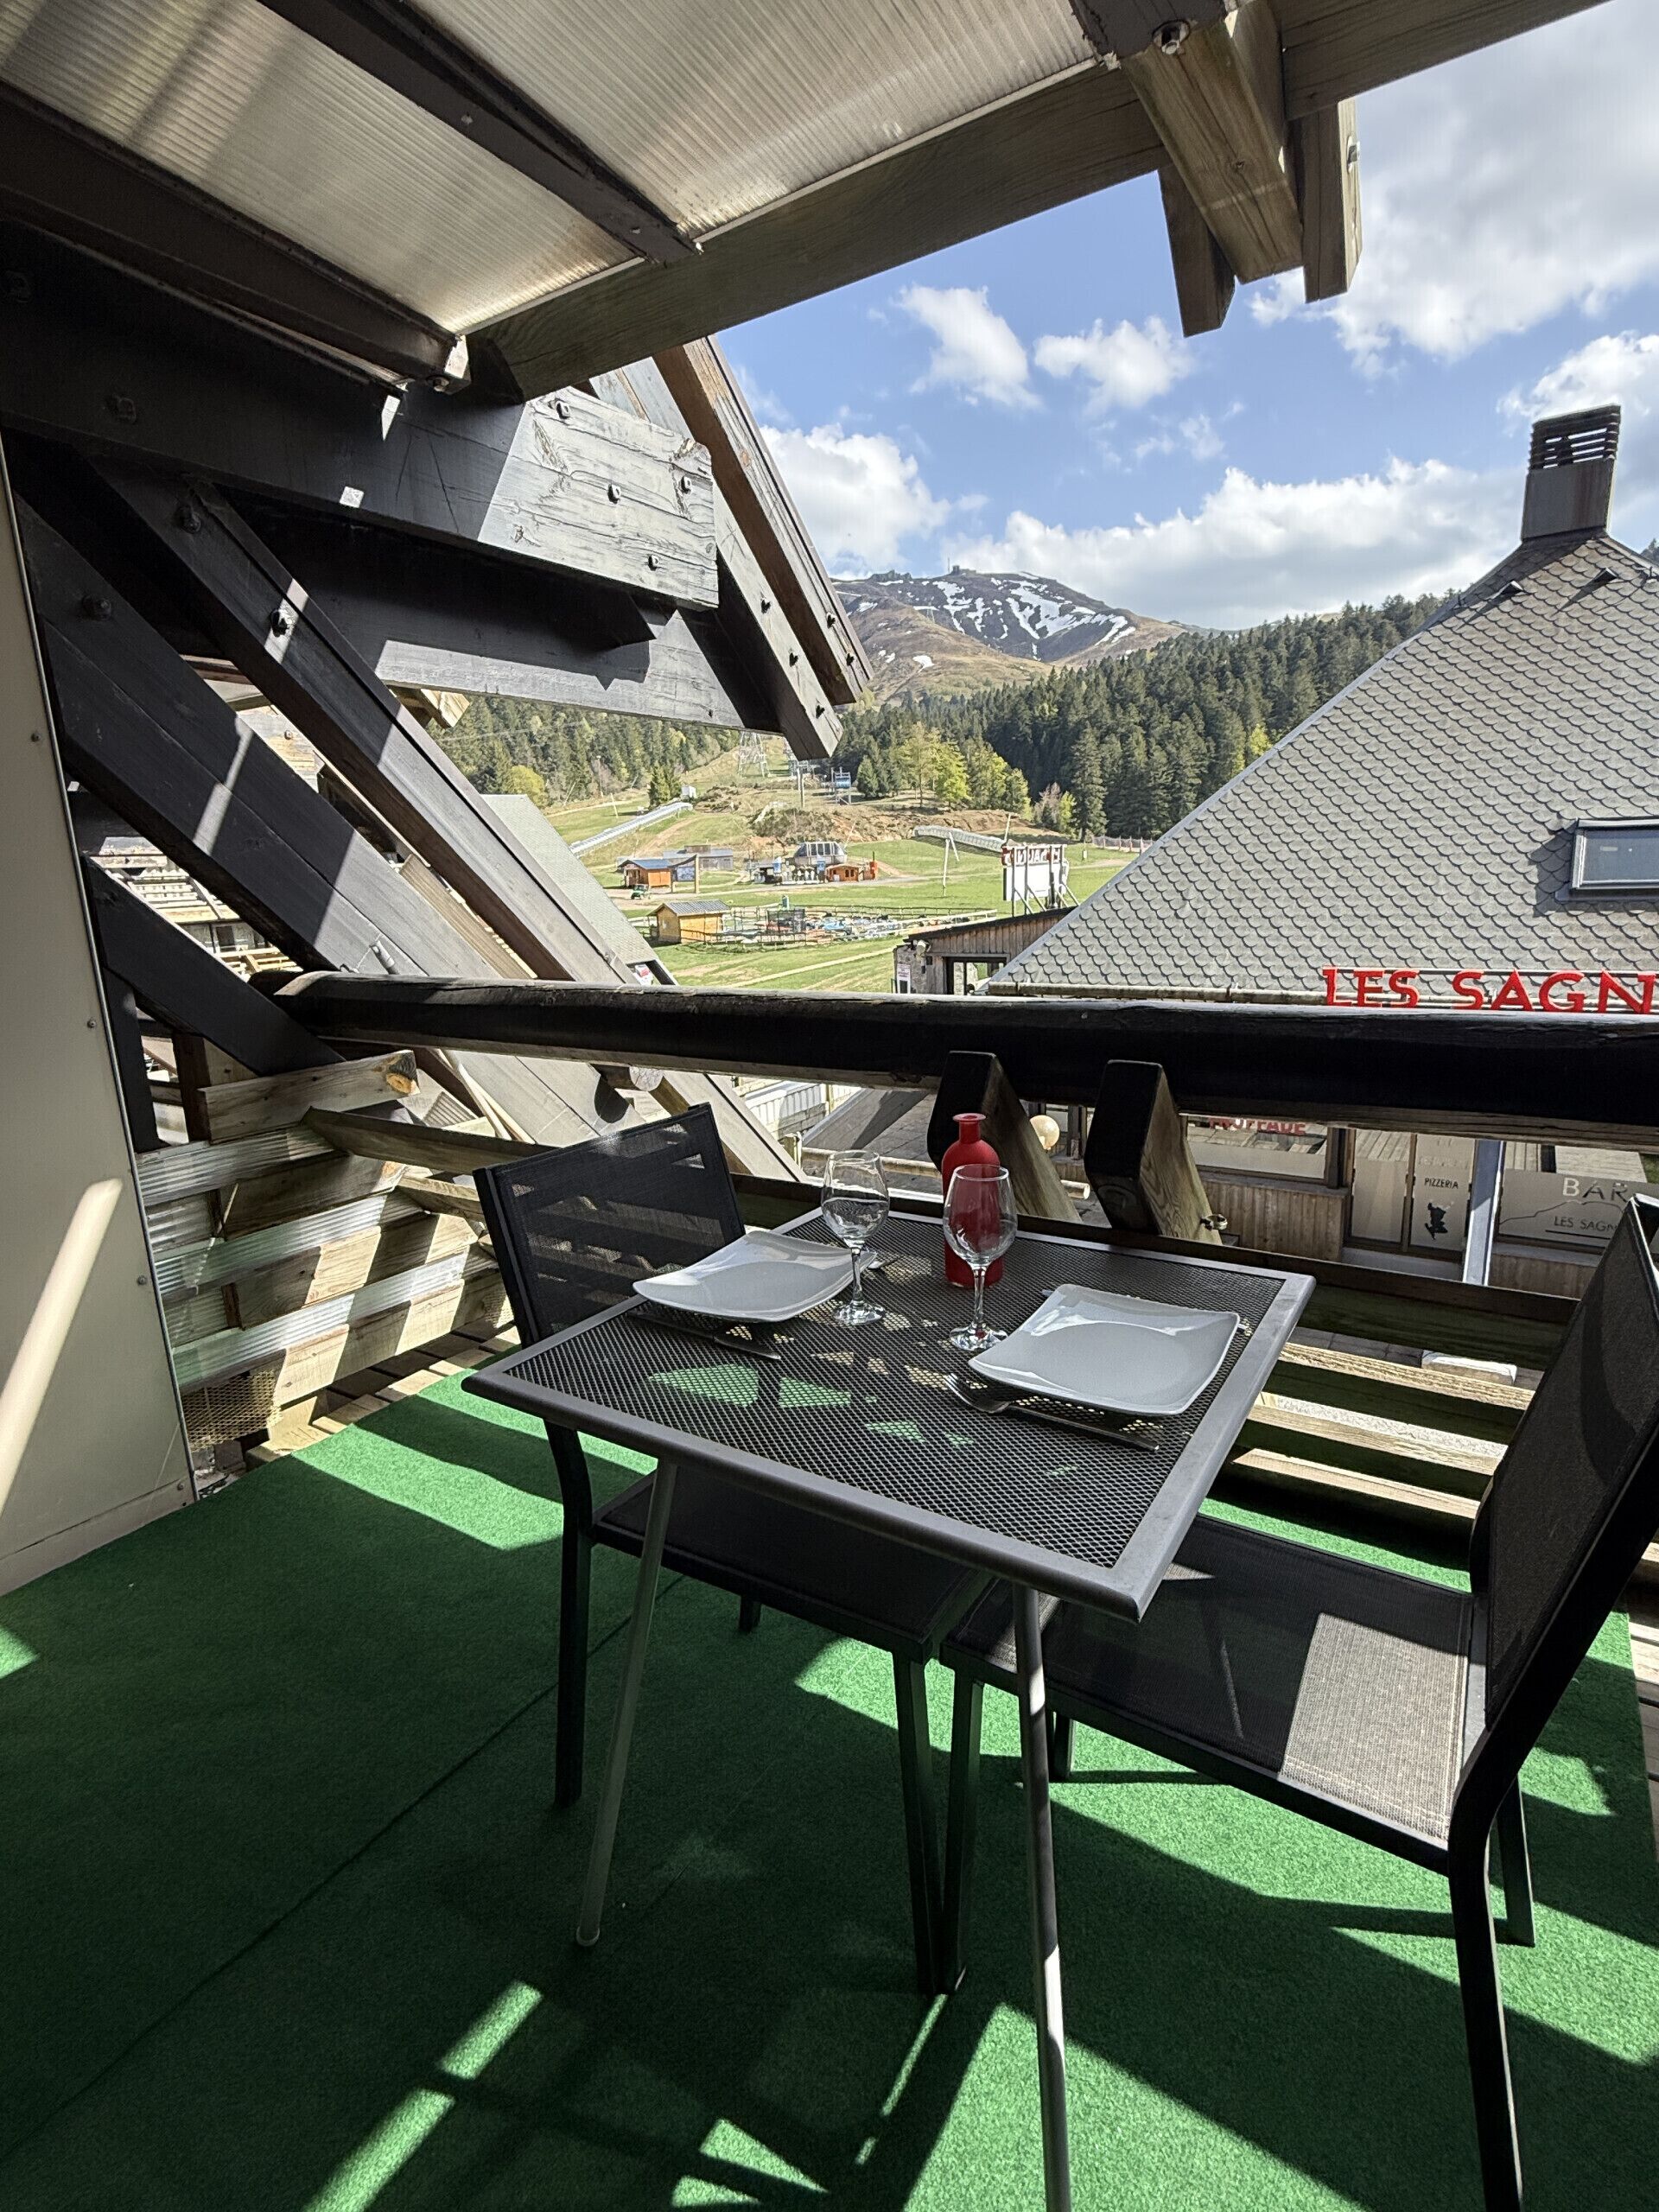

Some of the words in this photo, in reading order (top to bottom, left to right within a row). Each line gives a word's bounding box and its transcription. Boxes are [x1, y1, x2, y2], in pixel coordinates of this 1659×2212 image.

[1322, 967, 1419, 1008] LES
[1424, 1177, 1459, 1189] PIZZERIA
[1562, 1177, 1628, 1203] BAR
[1554, 1216, 1574, 1228] LES
